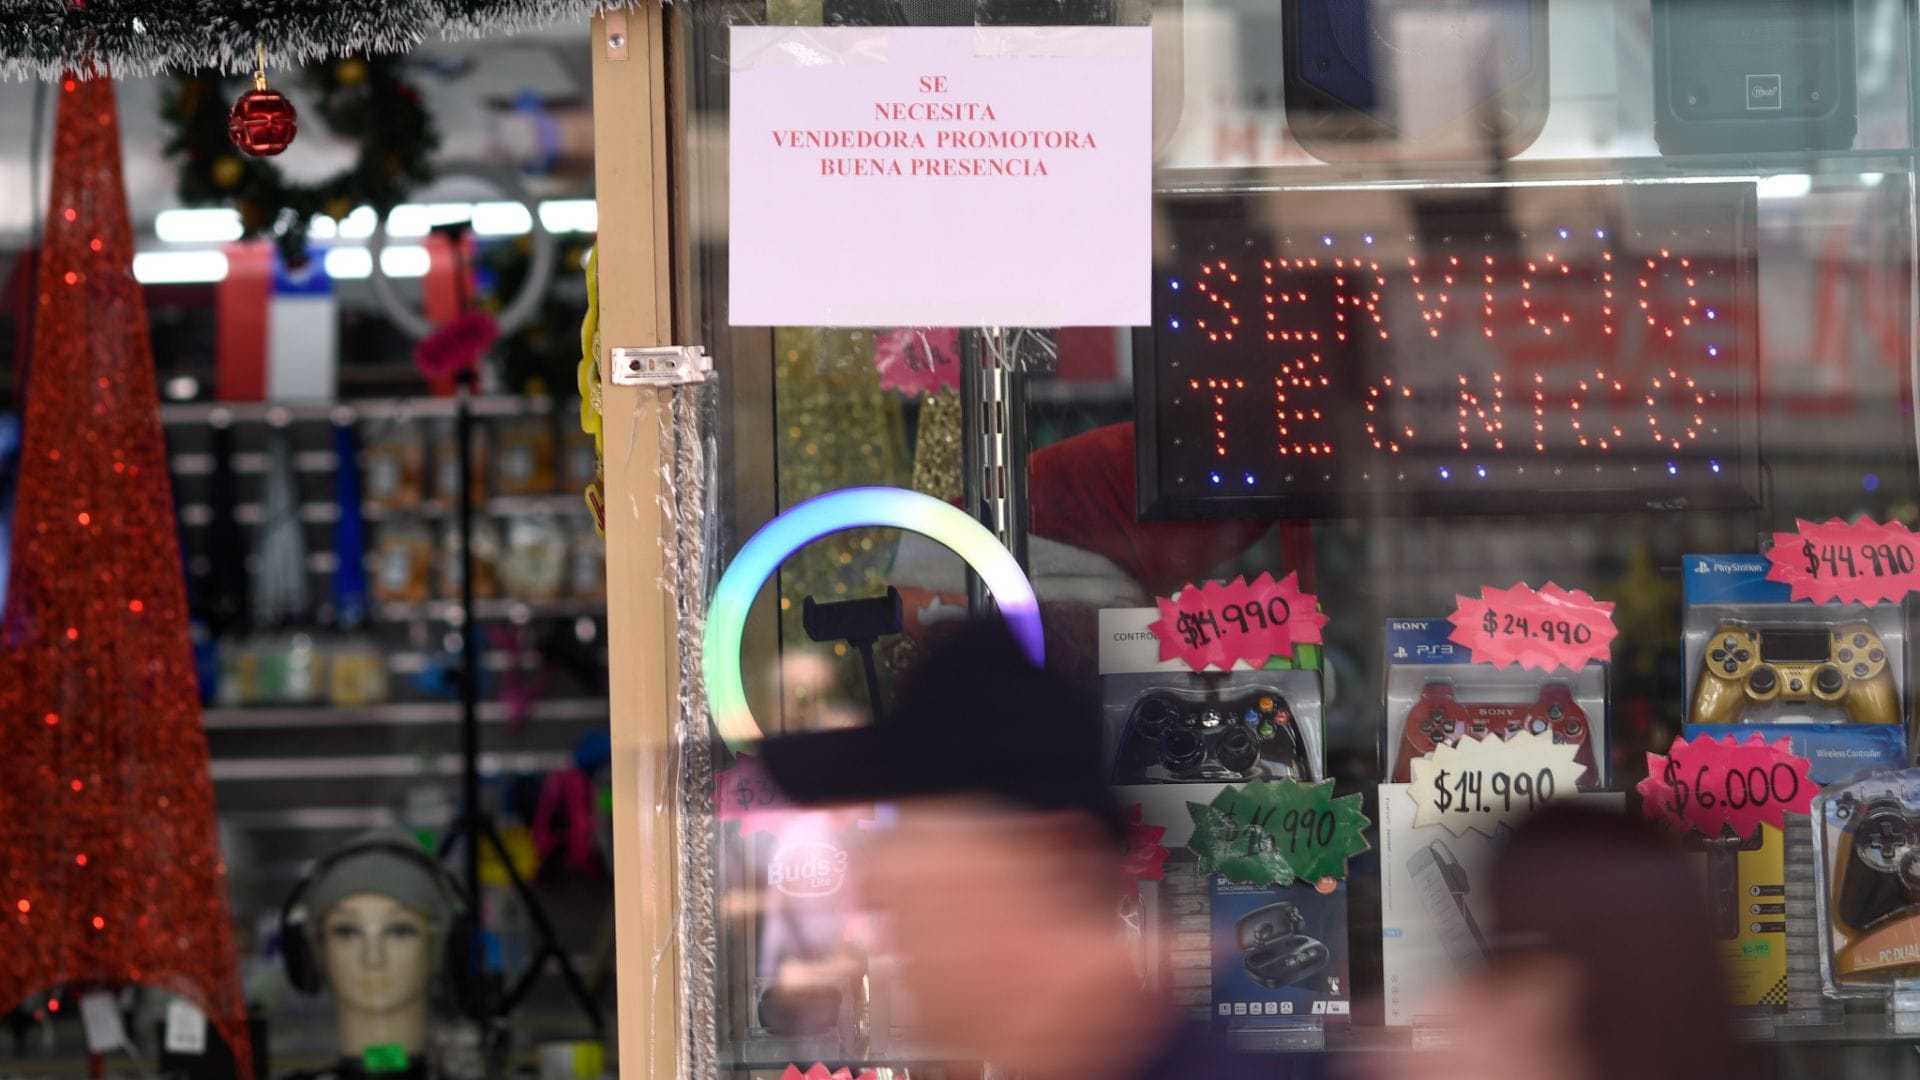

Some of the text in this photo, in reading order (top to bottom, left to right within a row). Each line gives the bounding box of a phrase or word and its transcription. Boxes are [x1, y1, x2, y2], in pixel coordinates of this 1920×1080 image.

[919, 75, 948, 93] SE
[874, 103, 996, 120] NECESITA
[772, 131, 1097, 148] VENDEDORA PROMOTORA
[820, 159, 1048, 176] BUENA PRESENCIA
[1196, 249, 1697, 342] SERVICIO
[1191, 353, 1704, 456] TÉCNICO
[1802, 539, 1915, 578] $44.990
[1713, 563, 1762, 576] PlayStation
[1392, 622, 1428, 630] SONY
[1482, 608, 1592, 645] $24.990
[1416, 644, 1453, 656] PS3
[1479, 708, 1514, 716] SONY
[1433, 767, 1556, 814] $14.990
[1663, 753, 1799, 820] $6.000
